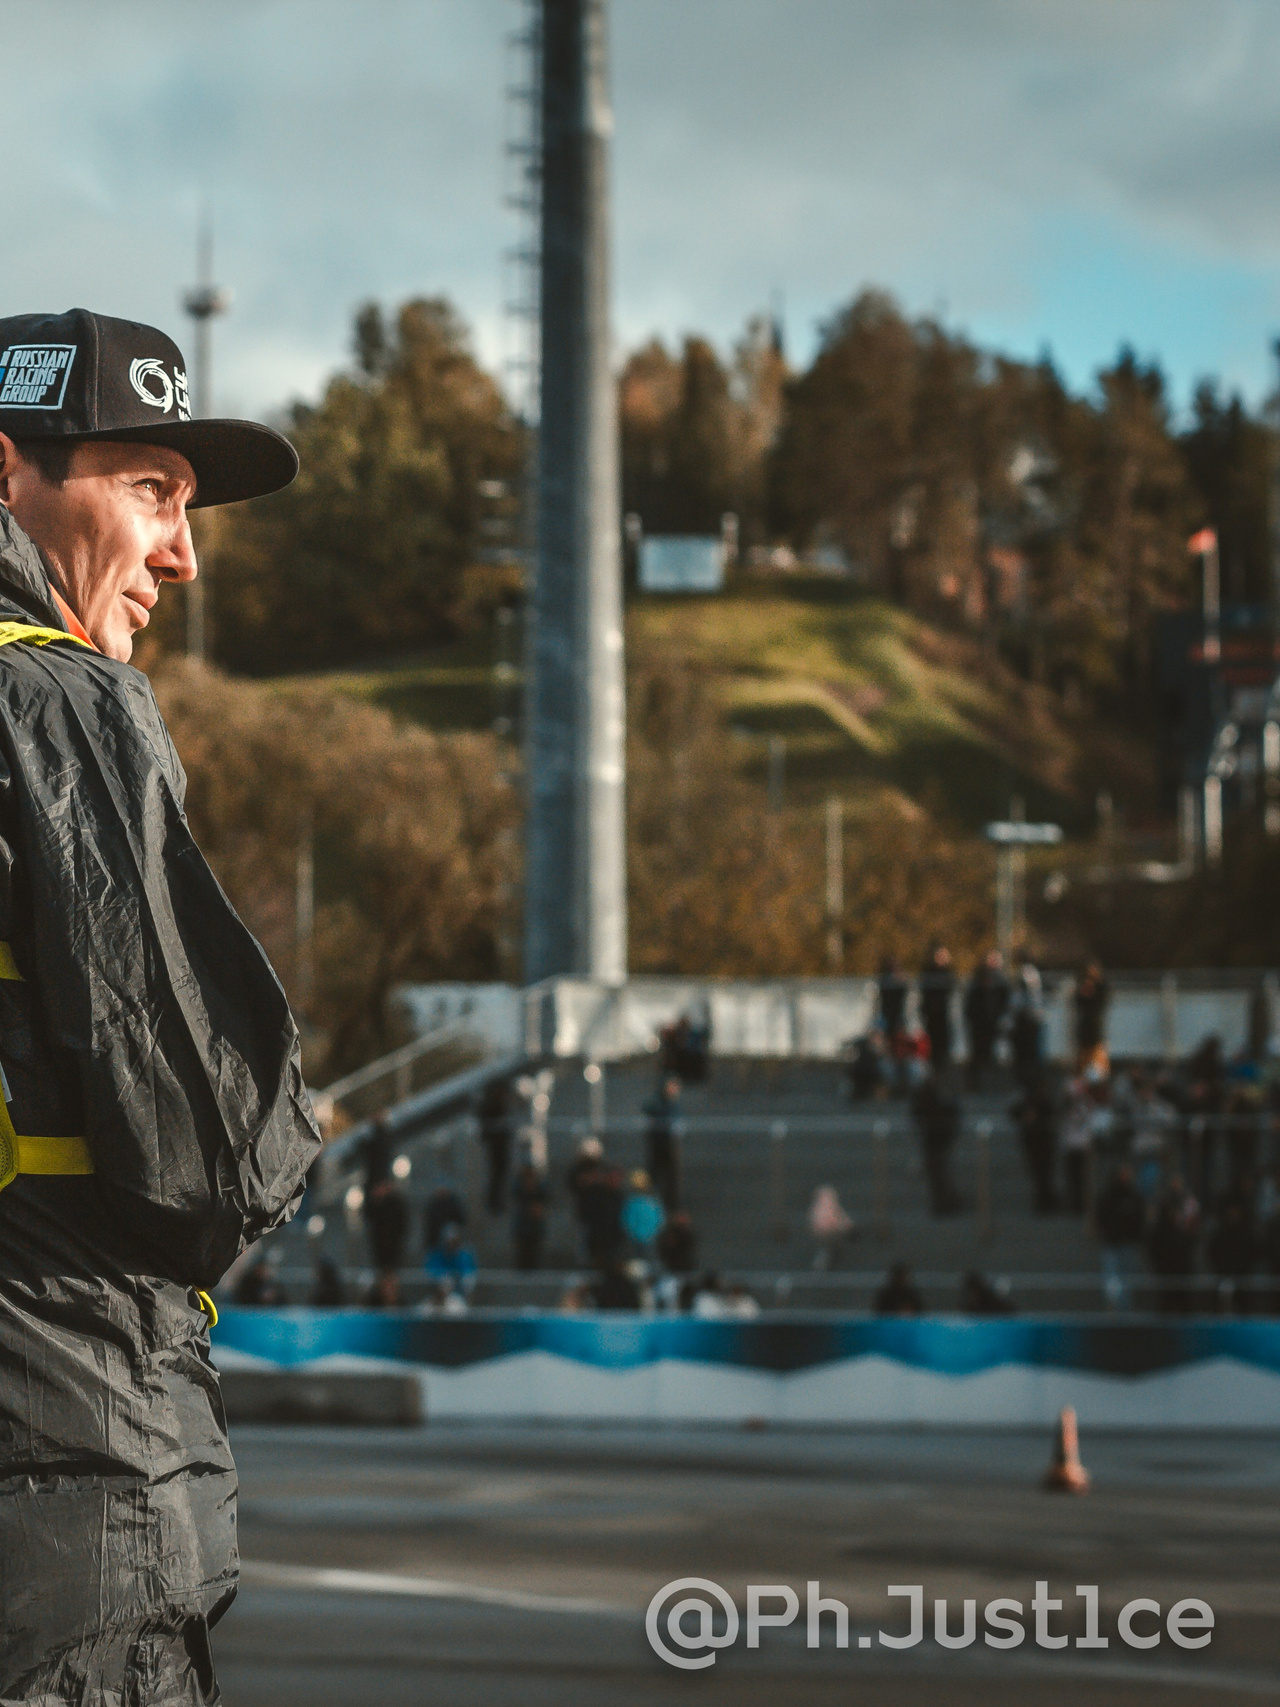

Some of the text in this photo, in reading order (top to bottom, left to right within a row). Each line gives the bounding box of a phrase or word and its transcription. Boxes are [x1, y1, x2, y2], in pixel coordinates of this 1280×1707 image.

[10, 350, 70, 368] RUSSIAN
[4, 367, 58, 386] RACING
[0, 385, 48, 403] GROUP
